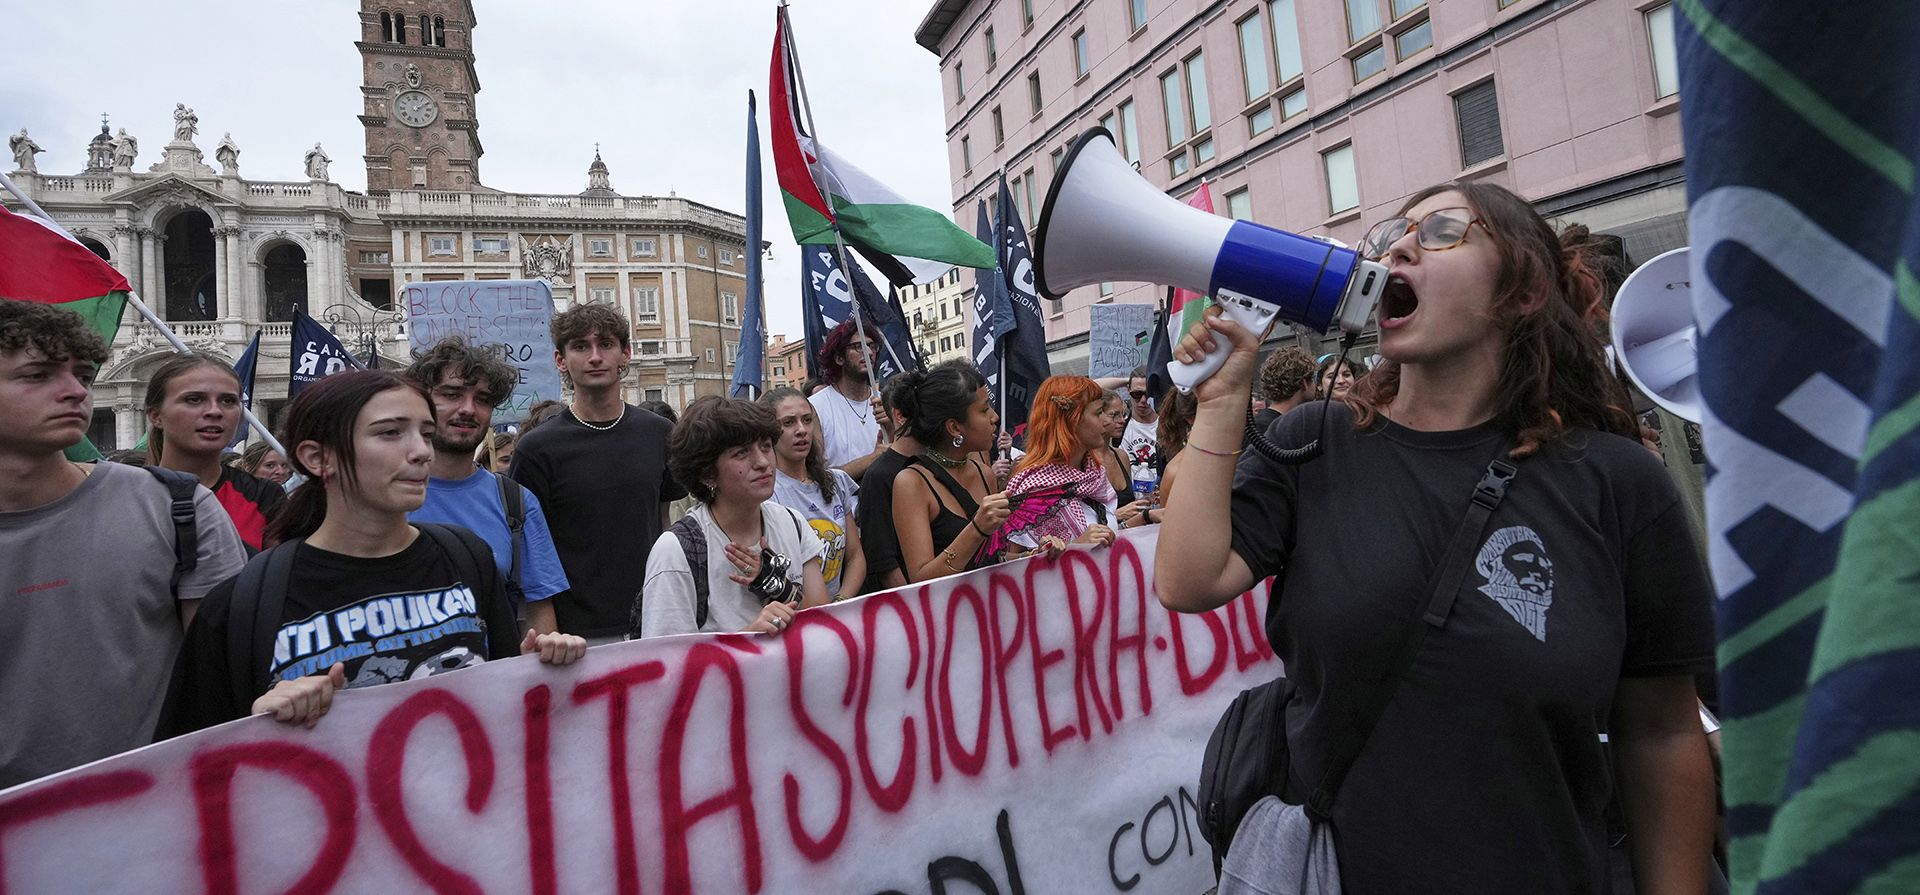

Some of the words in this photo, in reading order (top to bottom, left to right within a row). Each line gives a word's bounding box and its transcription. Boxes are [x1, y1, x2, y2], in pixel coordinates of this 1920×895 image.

[408, 286, 482, 317] BLOCK
[488, 286, 543, 313] THE
[269, 612, 332, 673] NTI
